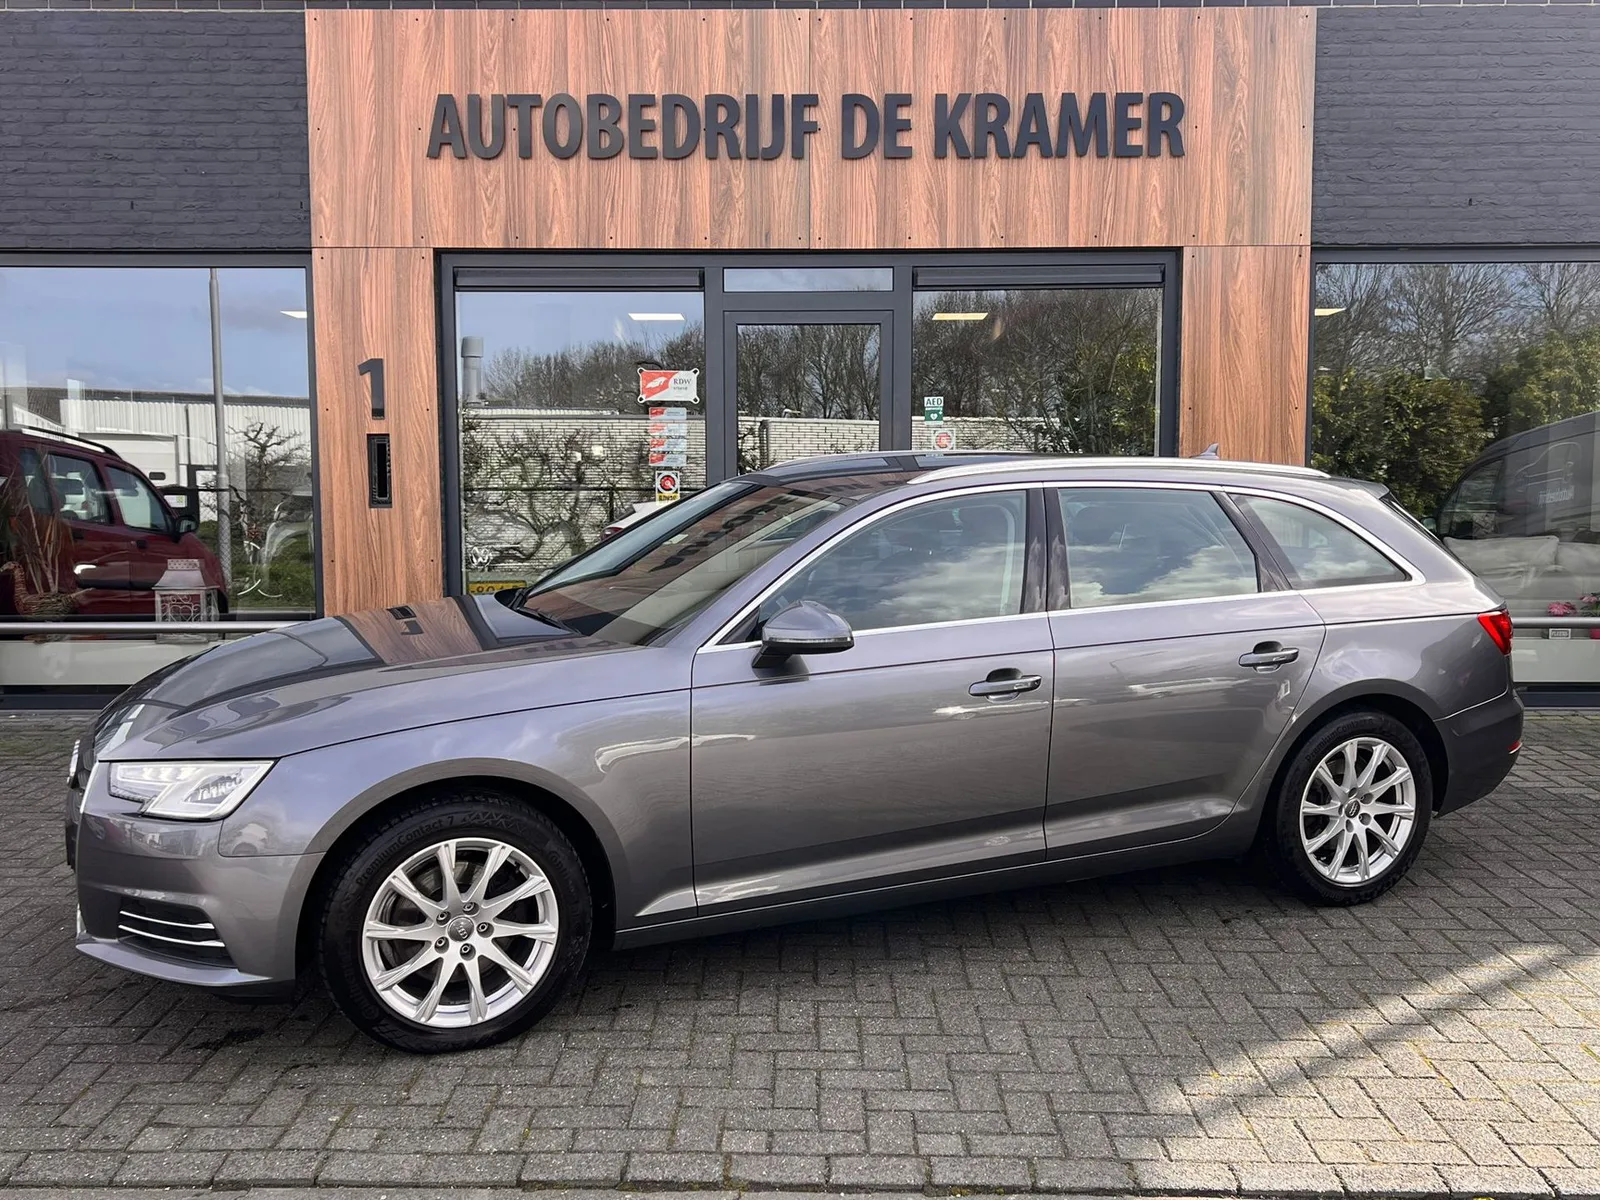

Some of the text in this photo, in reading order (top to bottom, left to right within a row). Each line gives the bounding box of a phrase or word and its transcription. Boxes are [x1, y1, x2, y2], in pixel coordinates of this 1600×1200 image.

[426, 92, 1186, 161] AUTOBEDRIJF DE KRAMER
[357, 358, 385, 419] 1
[447, 815, 454, 826] 7
